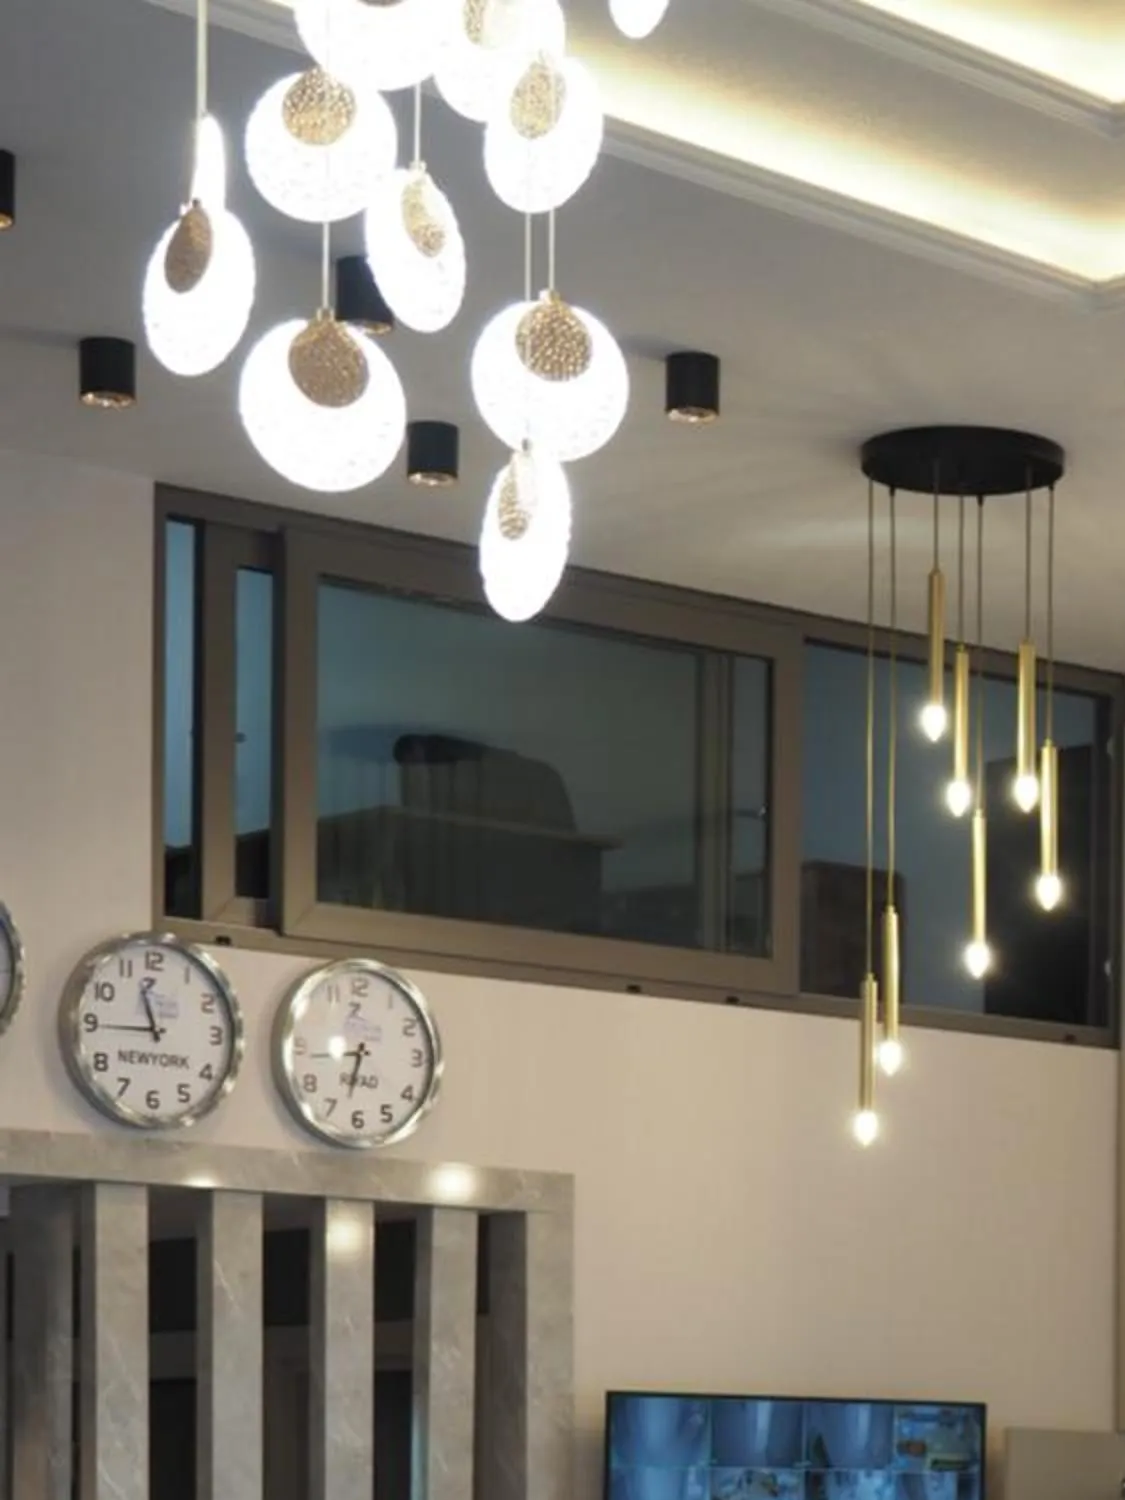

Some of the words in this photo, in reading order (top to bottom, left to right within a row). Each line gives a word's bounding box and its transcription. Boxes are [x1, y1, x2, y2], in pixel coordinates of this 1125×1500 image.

[119, 959, 132, 978] 11
[145, 951, 164, 972] 12
[94, 982, 115, 1002] 10
[351, 978, 369, 997] 12
[201, 994, 216, 1013] 2
[83, 1013, 98, 1033] 9
[402, 1018, 417, 1037] 2
[209, 1026, 223, 1046] 3
[94, 1053, 109, 1072] 8
[117, 1050, 190, 1070] NEWYORK
[411, 1050, 423, 1068] 3
[199, 1063, 213, 1081] 4
[339, 1071, 378, 1090] RAD
[117, 1078, 131, 1097] 7
[303, 1074, 317, 1093] 8
[401, 1084, 414, 1102] 4
[146, 1090, 160, 1110] 6
[177, 1084, 191, 1103] 5
[324, 1098, 337, 1118] 7
[380, 1104, 393, 1123] 5
[351, 1110, 365, 1129] 6
